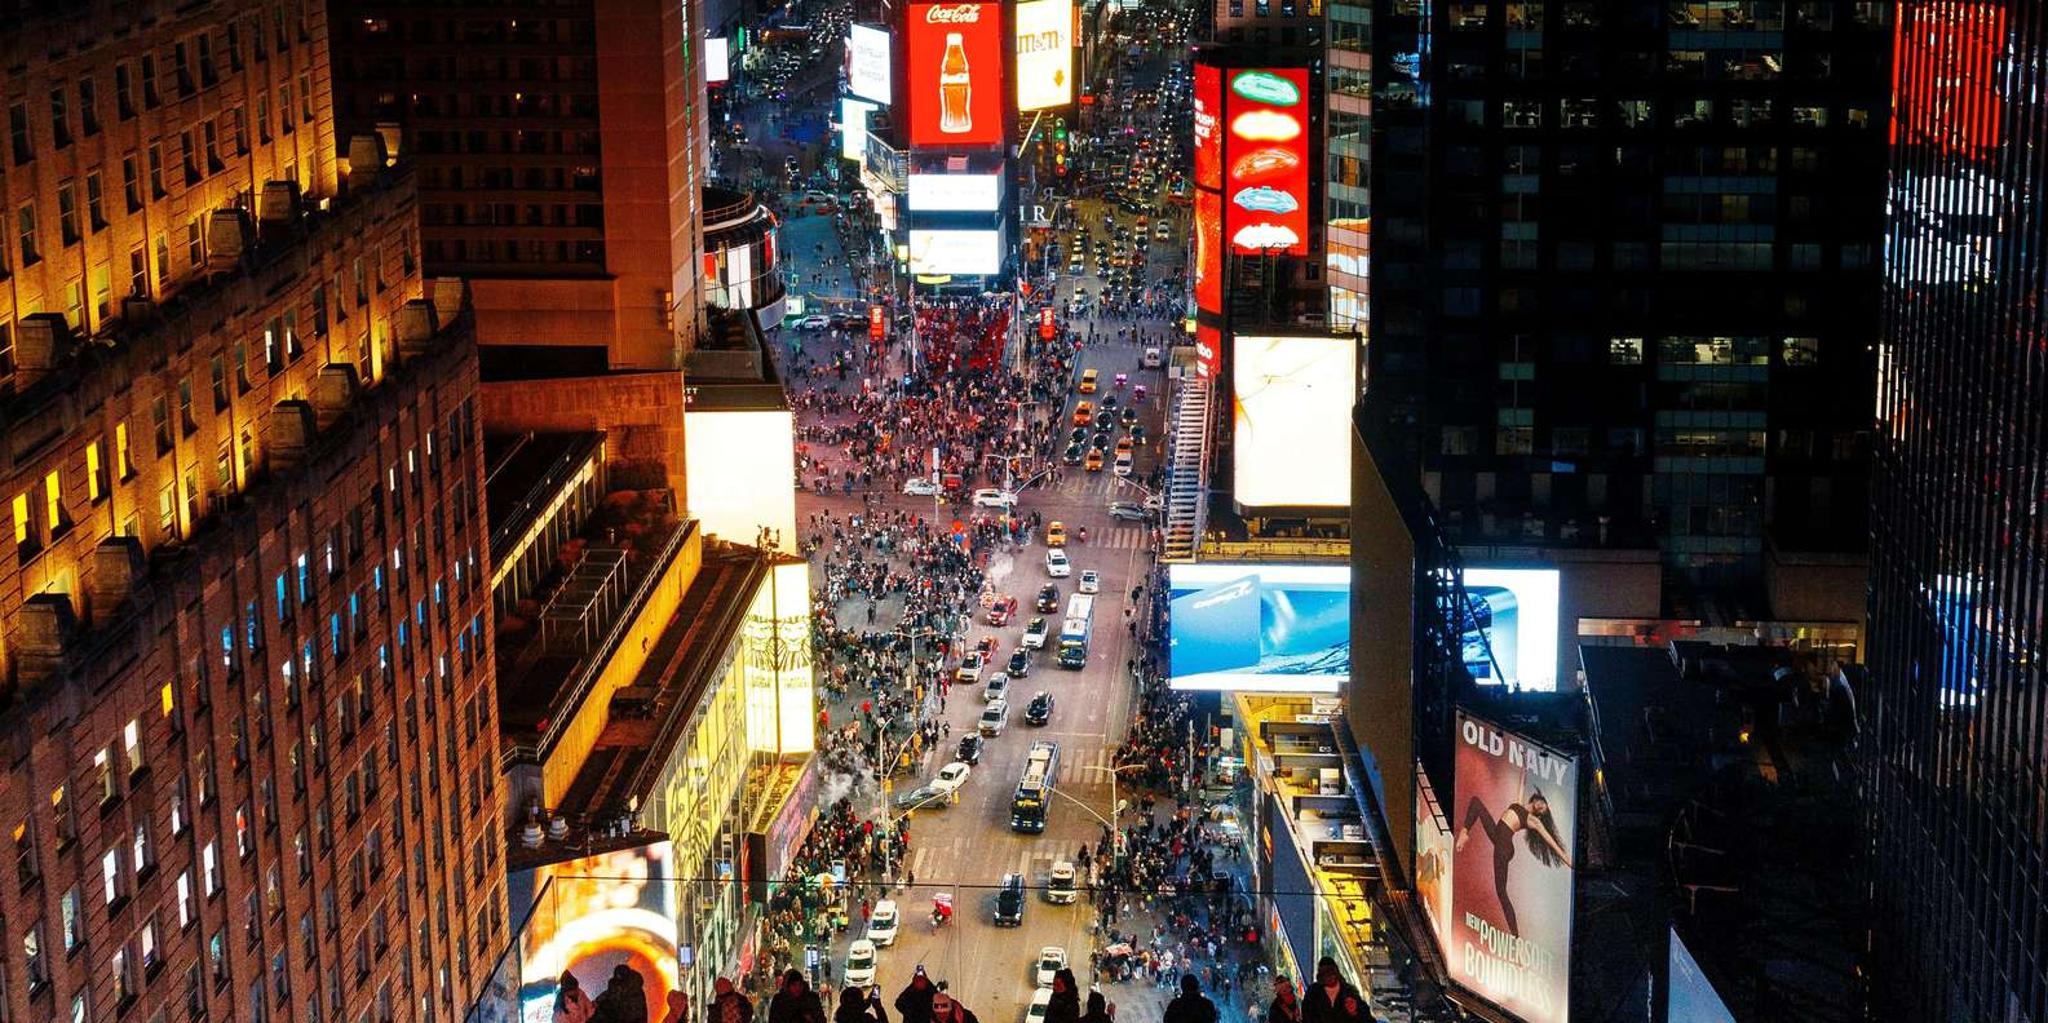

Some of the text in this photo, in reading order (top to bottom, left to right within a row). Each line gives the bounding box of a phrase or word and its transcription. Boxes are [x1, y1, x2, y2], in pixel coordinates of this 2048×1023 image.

[926, 4, 982, 23] Coca-Cola
[1463, 720, 1568, 786] OLD NAVY
[1465, 941, 1553, 1017] BOUNDLESS
